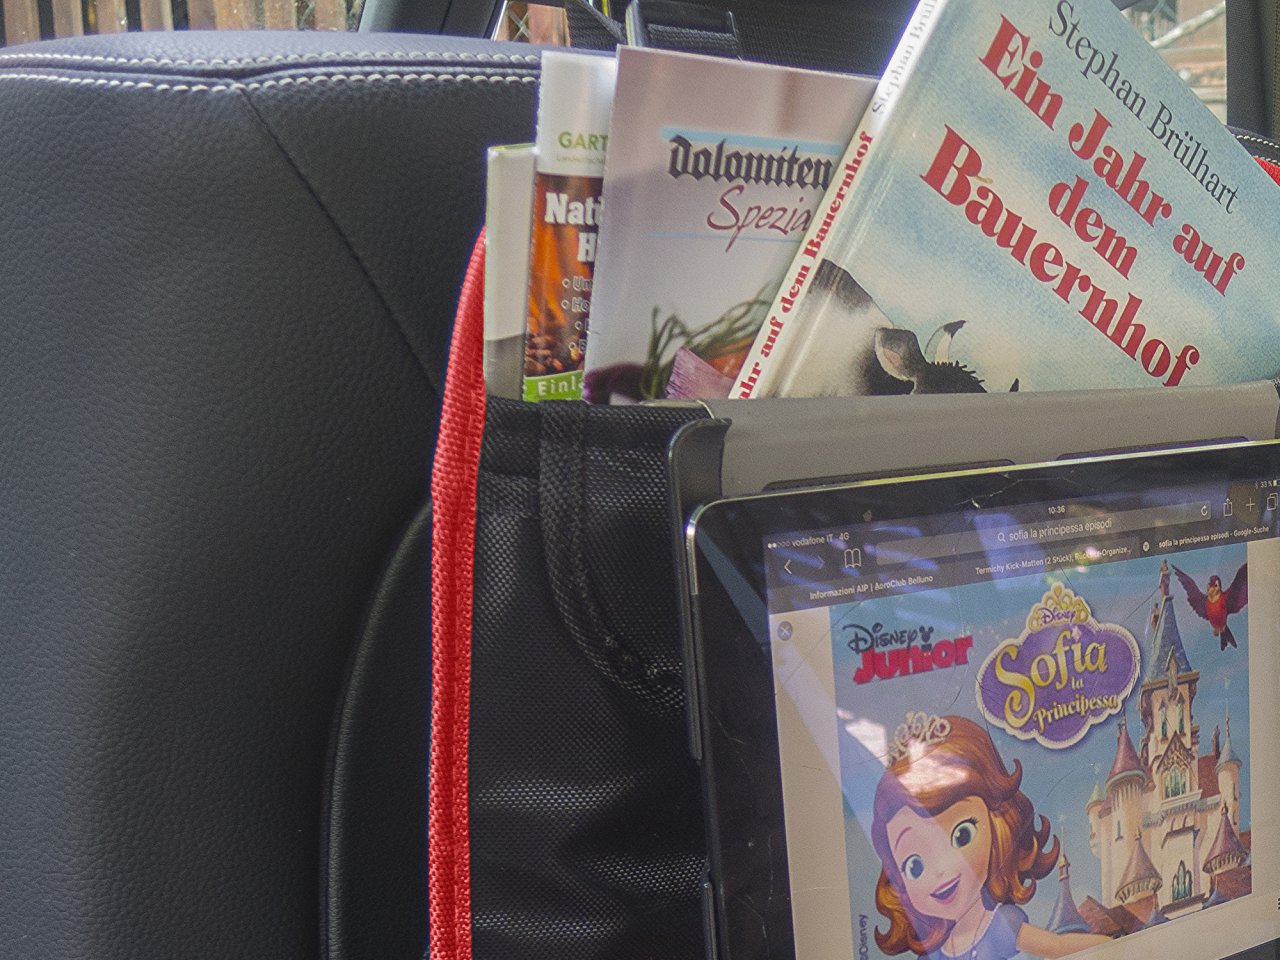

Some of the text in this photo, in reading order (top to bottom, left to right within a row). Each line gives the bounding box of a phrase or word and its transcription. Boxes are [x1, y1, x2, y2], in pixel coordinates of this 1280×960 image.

[1048, 0, 1240, 214] Stephan Brülhart
[668, 134, 833, 192] Dolomiten
[979, 15, 1246, 297] Ein Jahr auf
[707, 185, 812, 252] Spezia
[760, 316, 784, 358] auf
[779, 265, 811, 314] dem
[802, 131, 874, 259] Bauernhof
[1048, 175, 1139, 281] dem
[920, 124, 1201, 387] Bauernhof
[791, 532, 850, 547] vodafone IT 4G
[1008, 518, 1113, 541] sofia la principessa episodi
[1158, 540, 1173, 549] sofia
[1179, 534, 1210, 546] principessa
[1210, 531, 1230, 542] episodi
[1233, 525, 1270, 538] Google-Suche
[809, 586, 856, 601] Informazioni
[856, 585, 869, 593] AIP
[908, 575, 934, 586] Belluno
[995, 629, 1108, 729] Sofia
[1070, 676, 1085, 691] la
[1032, 693, 1120, 734] Principessa
